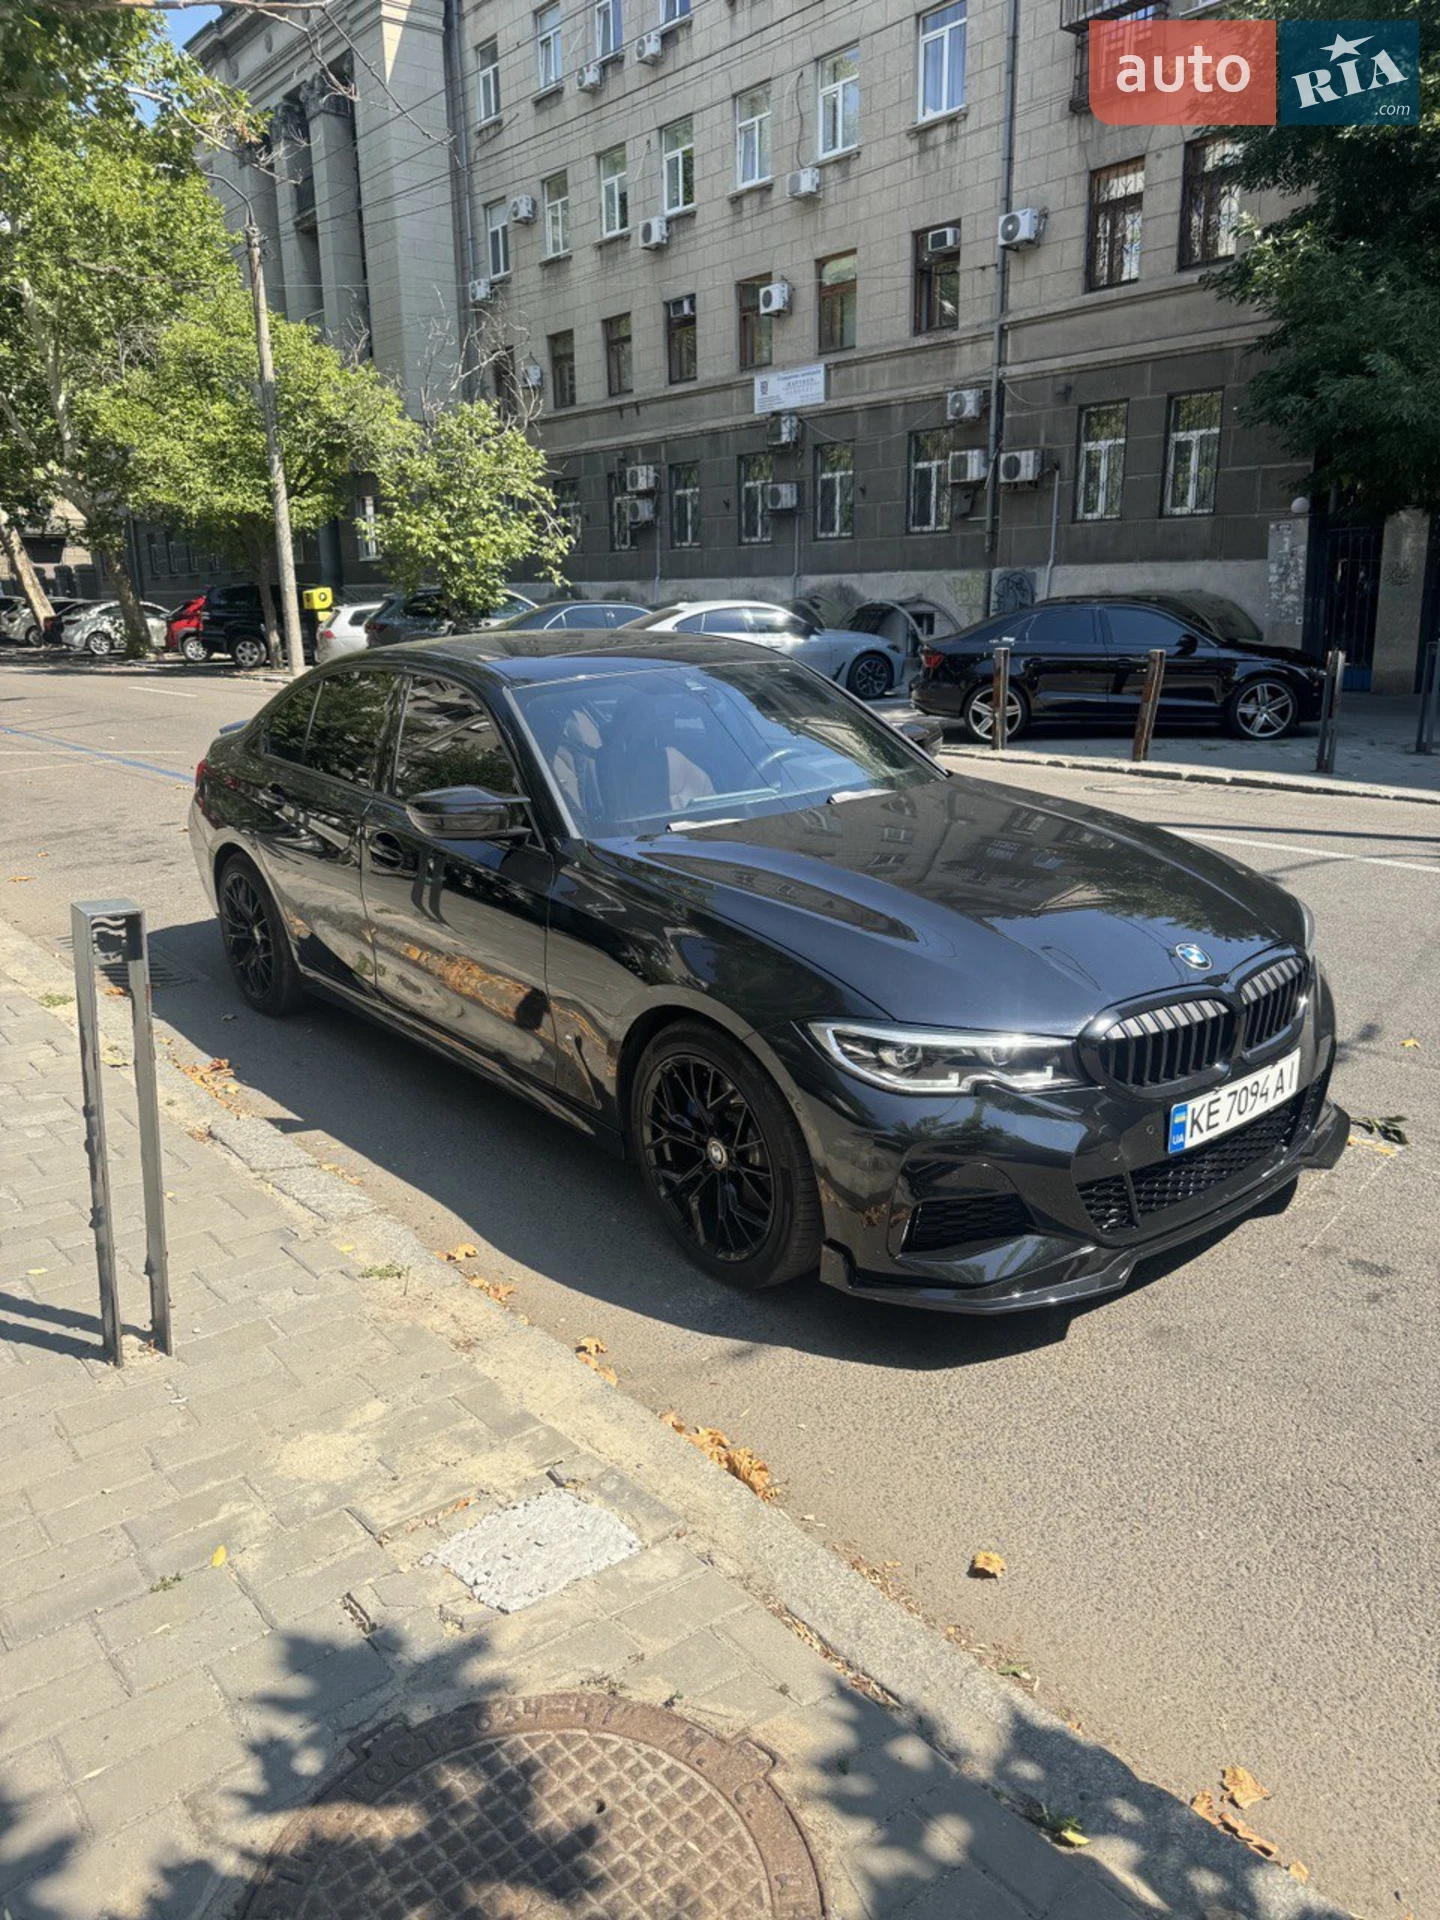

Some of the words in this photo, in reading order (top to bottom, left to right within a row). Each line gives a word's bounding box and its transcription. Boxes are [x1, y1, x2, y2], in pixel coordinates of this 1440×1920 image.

[1189, 1097, 1222, 1138] KE
[1226, 1074, 1270, 1123] 7094
[1273, 1061, 1295, 1098] AI
